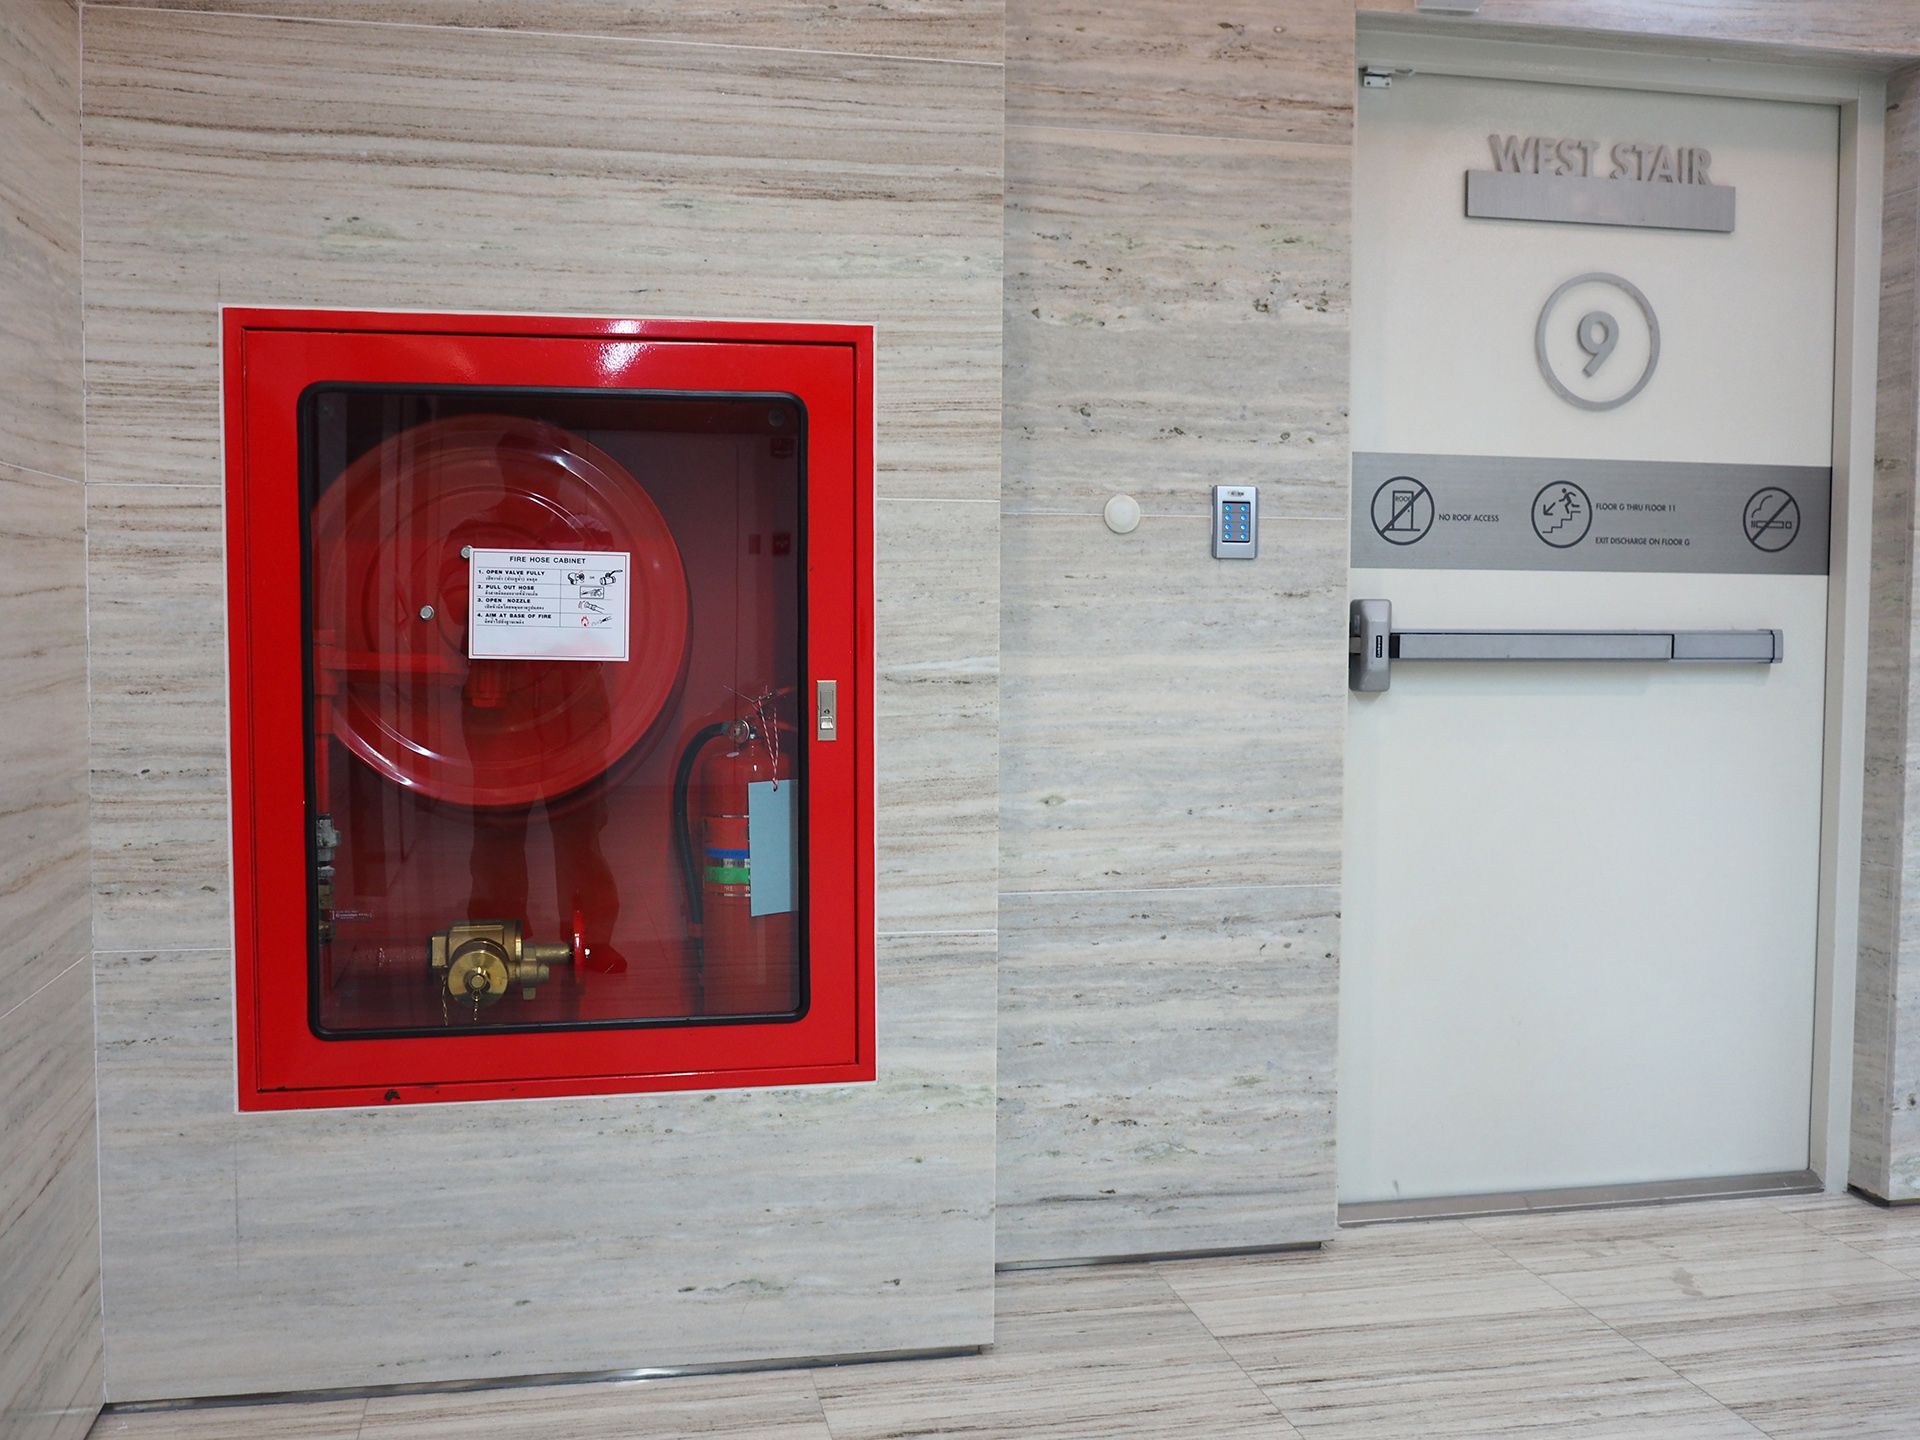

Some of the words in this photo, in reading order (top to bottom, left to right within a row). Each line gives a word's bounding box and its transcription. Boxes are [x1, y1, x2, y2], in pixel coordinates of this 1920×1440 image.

[1488, 133, 1600, 177] WEST
[1609, 142, 1713, 185] STAIR
[1577, 310, 1620, 378] 9
[1619, 503, 1625, 511] G
[1645, 504, 1666, 512] FLOOR
[1668, 504, 1676, 512] 11
[1438, 513, 1450, 521] NO
[1452, 514, 1472, 522] ROOF
[1473, 514, 1500, 522] ACCESS
[1610, 537, 1647, 545] DISCHARGE
[1649, 537, 1660, 545] ON
[1662, 538, 1683, 546] FLOOR
[1684, 538, 1690, 546] G
[529, 556, 551, 564] HOSE
[553, 557, 586, 565] CABINET
